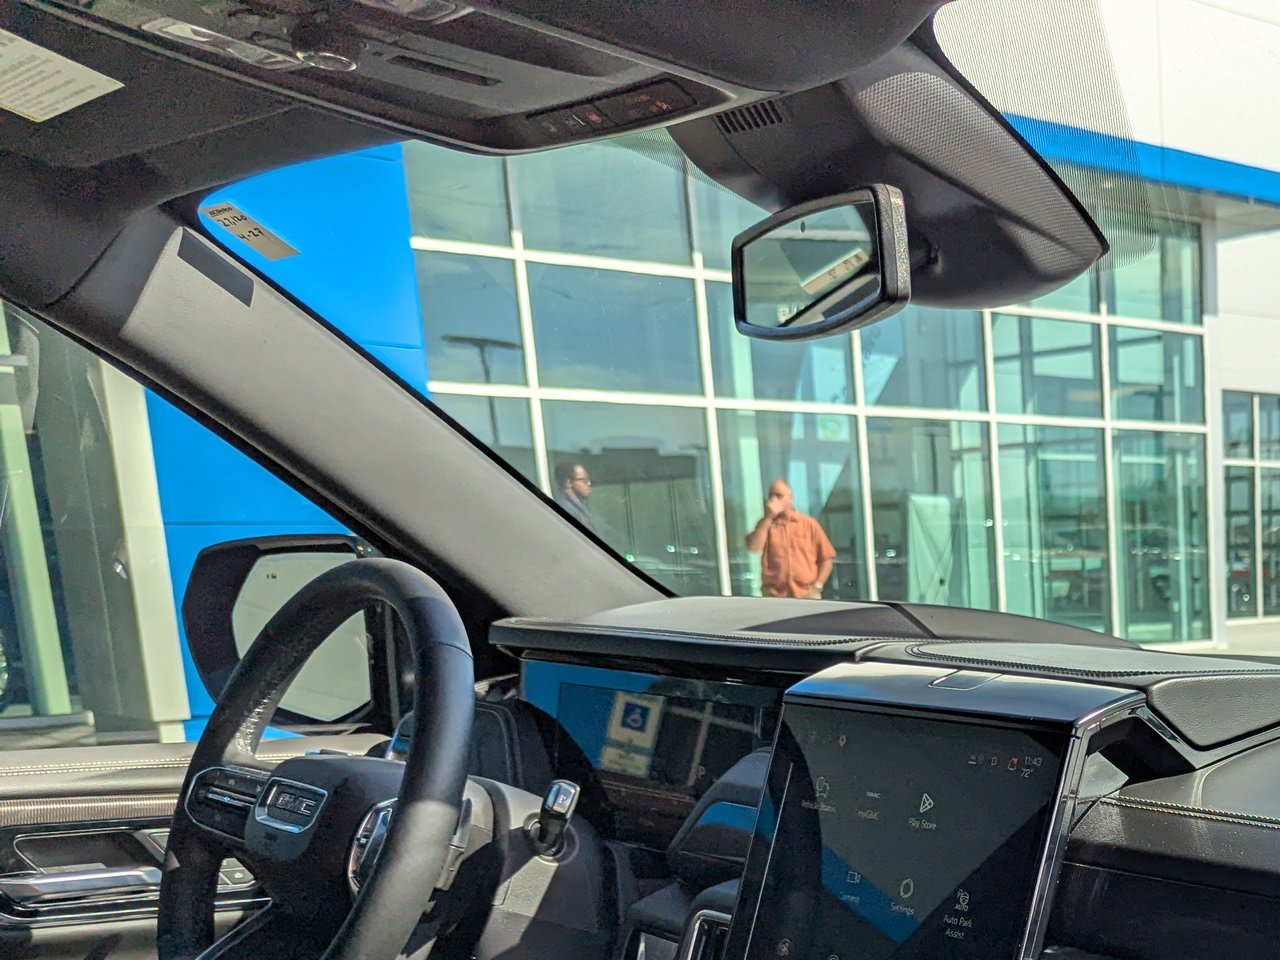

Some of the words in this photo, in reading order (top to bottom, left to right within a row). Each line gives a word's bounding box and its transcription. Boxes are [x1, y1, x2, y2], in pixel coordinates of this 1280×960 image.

[908, 817, 921, 830] Play
[921, 820, 937, 831] Store
[890, 902, 915, 918] Settings
[943, 914, 958, 926] Auto
[958, 917, 973, 929] Park
[945, 928, 965, 940] Assist
